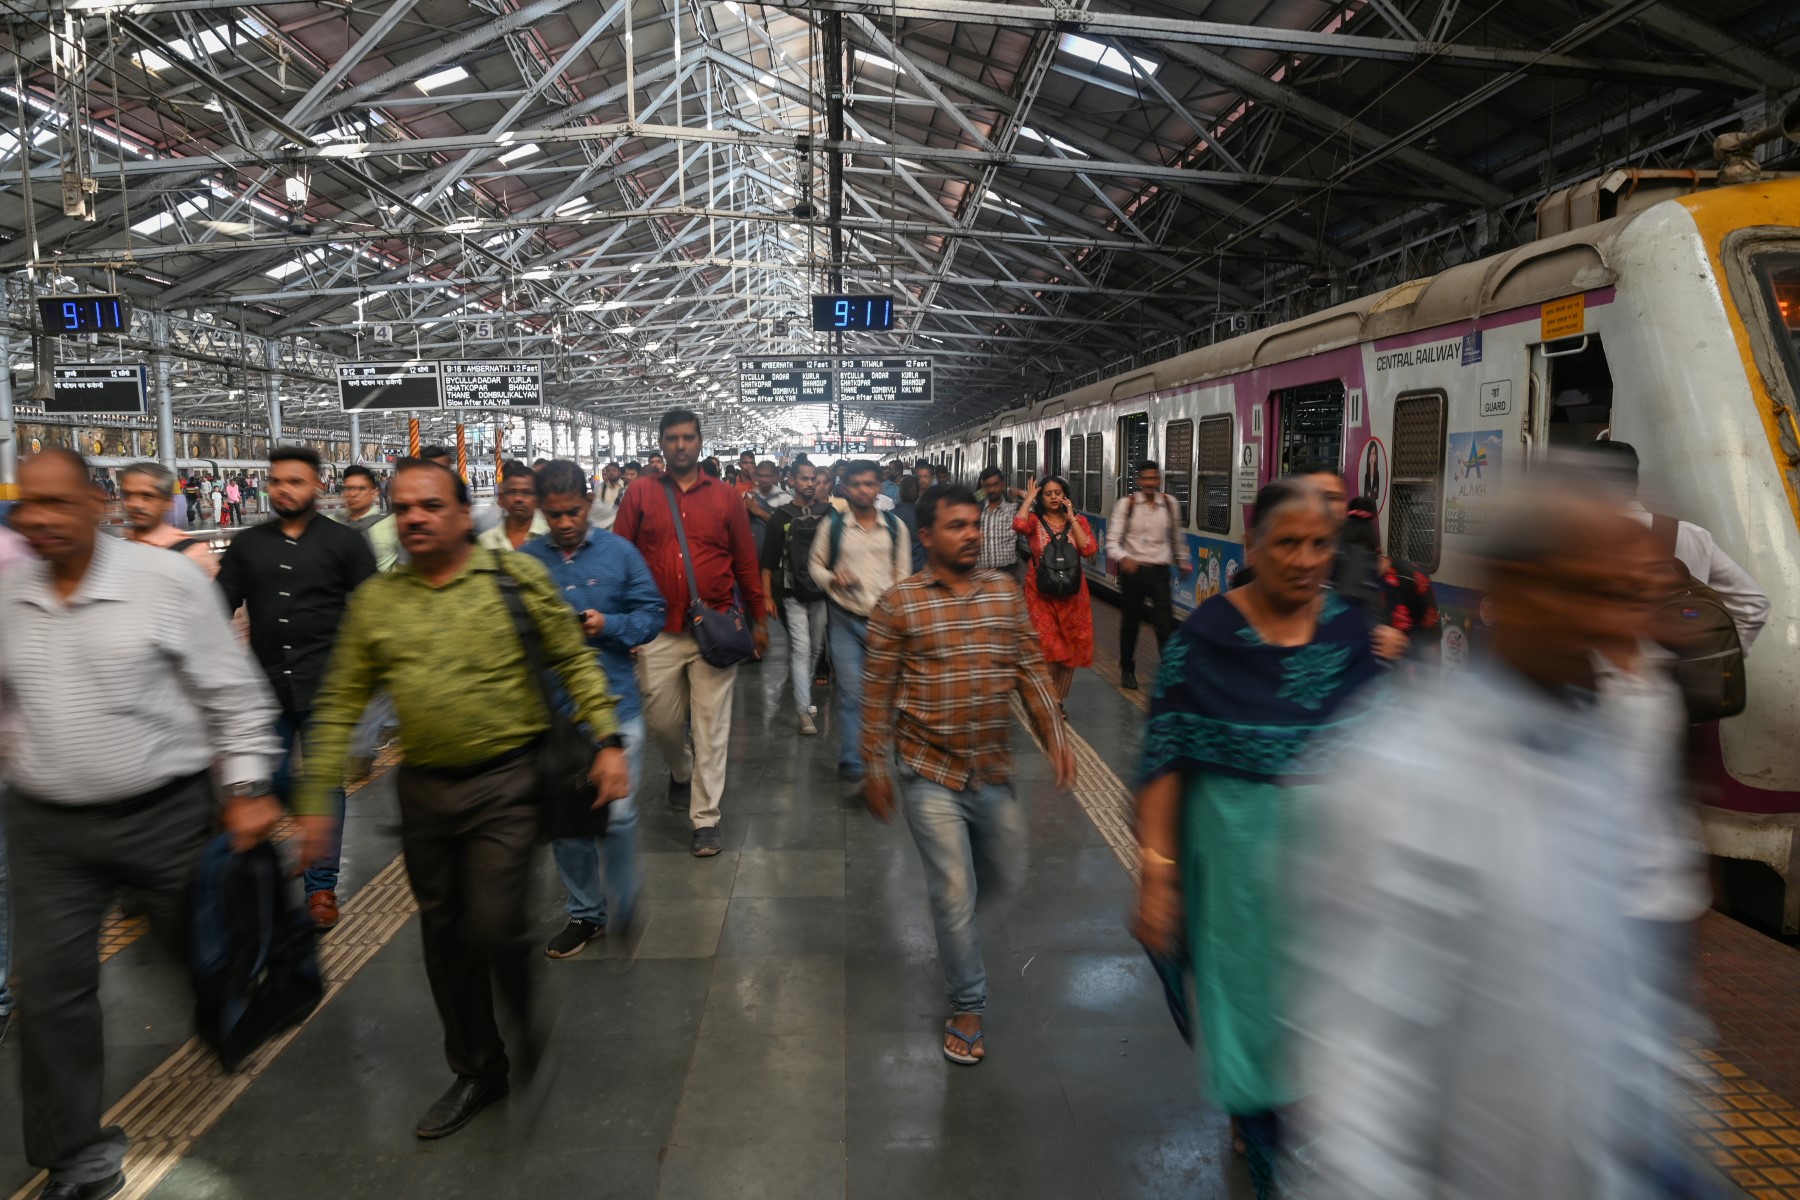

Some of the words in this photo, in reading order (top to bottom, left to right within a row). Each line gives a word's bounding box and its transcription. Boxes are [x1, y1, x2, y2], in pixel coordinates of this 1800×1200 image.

[63, 301, 120, 329] 9:11
[834, 300, 889, 327] 9:11
[775, 322, 785, 334] 5
[1235, 316, 1246, 329] 6
[376, 326, 388, 339] 4
[478, 325, 489, 337] 5
[1376, 351, 1414, 371] CENTRAL
[1415, 343, 1461, 365] RAILWAY
[761, 361, 794, 369] AMBERNATH
[110, 370, 118, 378] 12
[445, 376, 477, 384] BYCULLA
[477, 376, 501, 384] DADAR
[508, 376, 532, 384] KURLA
[740, 373, 765, 381] BYCULLA
[901, 371, 919, 379] KURLA
[741, 388, 759, 396] THANE
[871, 386, 897, 394] DOMBIVLI
[1485, 401, 1506, 413] GUARD
[1446, 508, 1459, 520] 022
